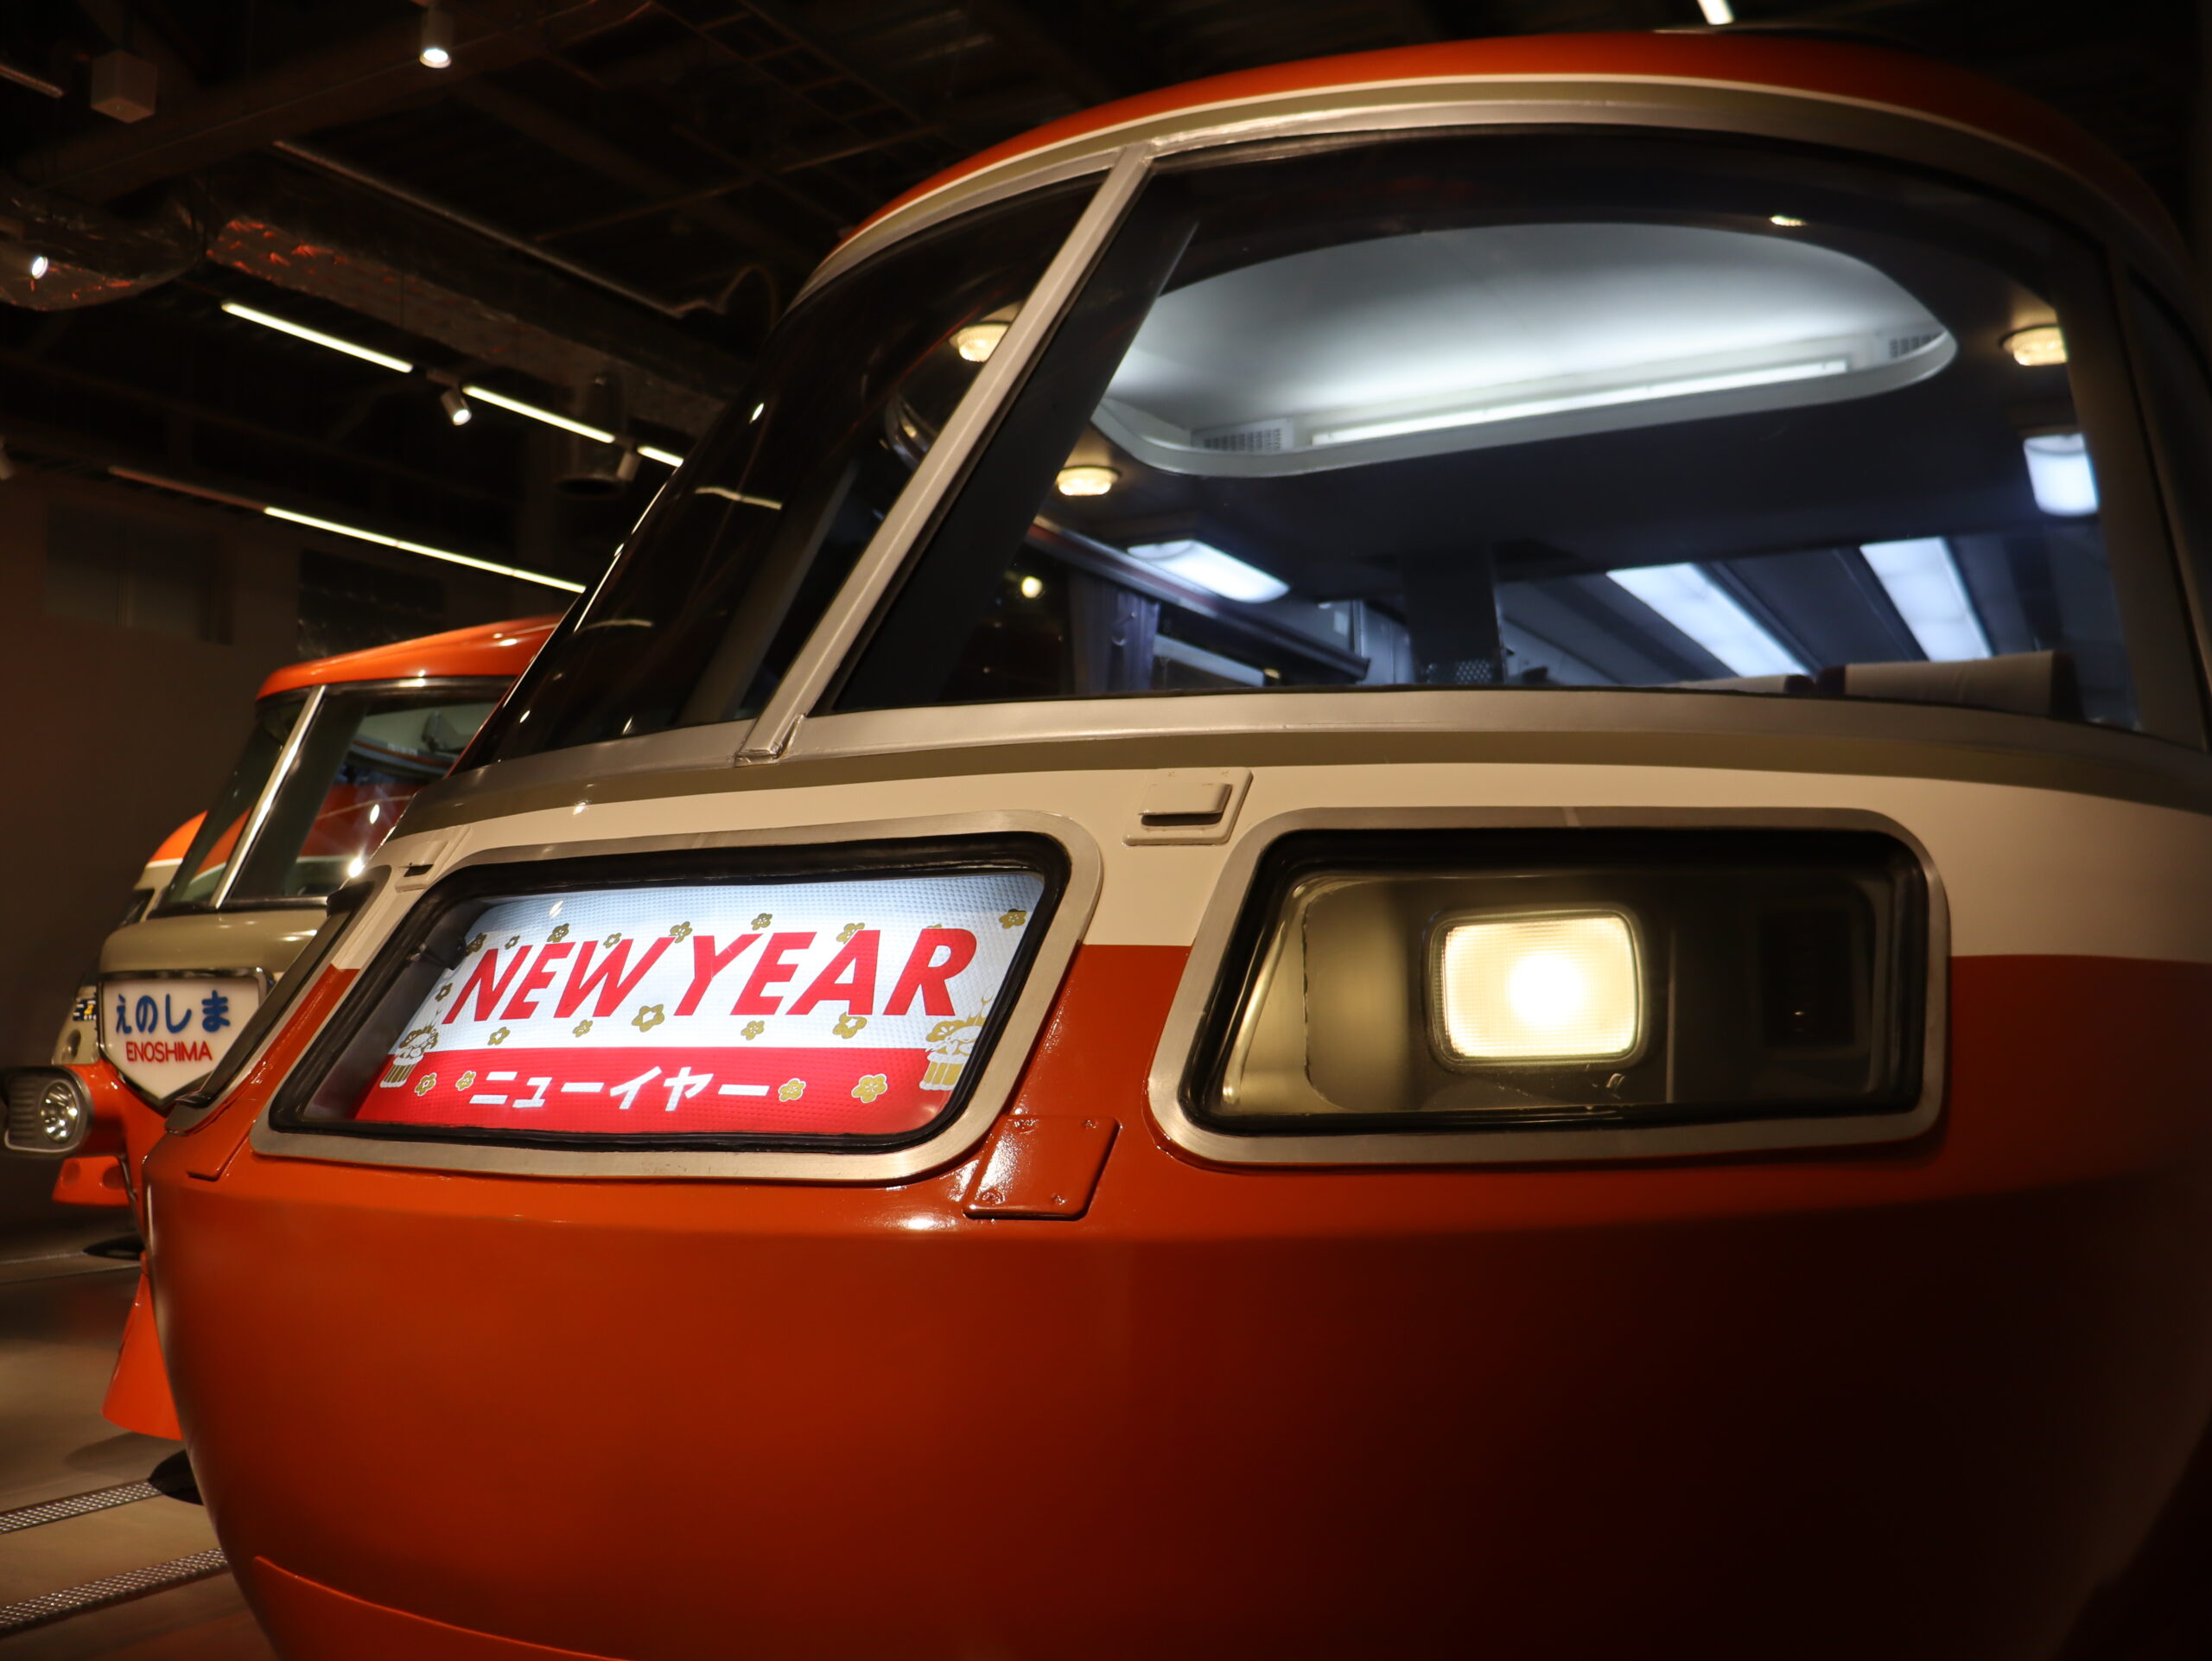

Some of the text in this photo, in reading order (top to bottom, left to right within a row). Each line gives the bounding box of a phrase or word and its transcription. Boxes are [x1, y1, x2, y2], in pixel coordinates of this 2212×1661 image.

[442, 927, 978, 1025] NEW YEAR
[116, 990, 230, 1034] えのしま
[126, 1041, 213, 1062] ENOSHIMA
[468, 1066, 771, 1112] ニューイヤー
